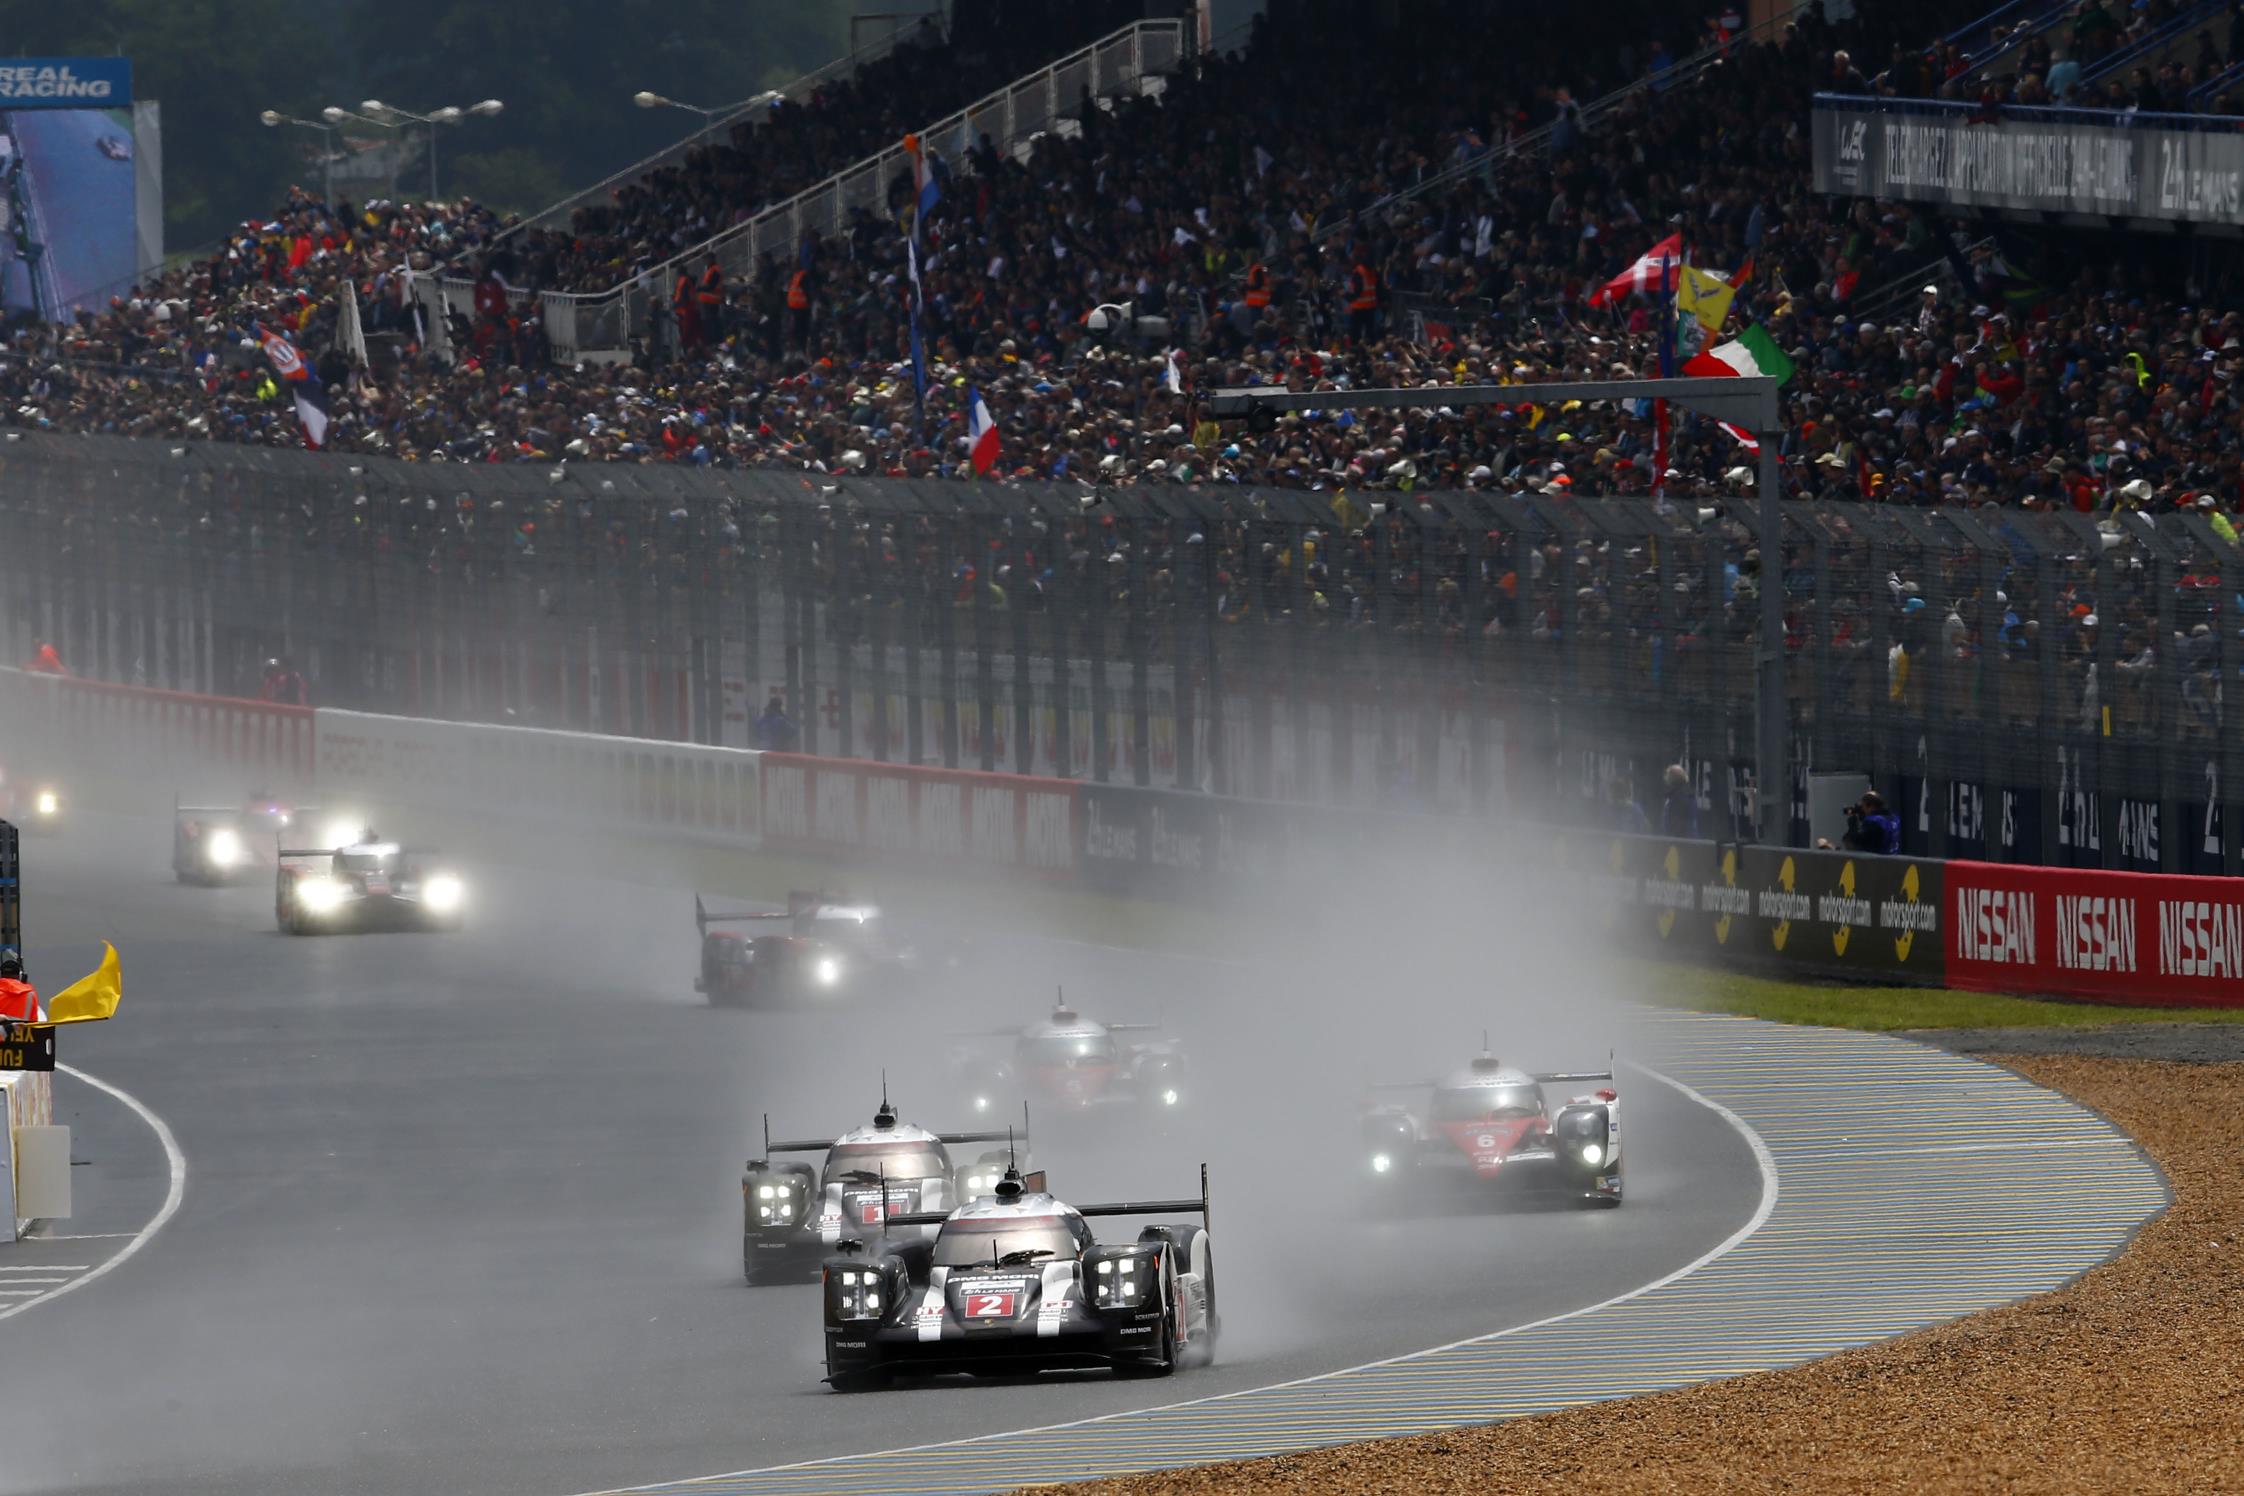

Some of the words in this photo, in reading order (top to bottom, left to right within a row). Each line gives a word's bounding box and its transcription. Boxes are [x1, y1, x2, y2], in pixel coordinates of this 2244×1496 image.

[0, 66, 78, 81] REAL
[0, 80, 112, 97] RACING
[1758, 885, 1811, 921] motorsport.com
[1818, 890, 1872, 928] motorsport.com
[1880, 895, 1936, 934] motorsport.com
[1957, 887, 2036, 965] NISSAN
[2056, 895, 2137, 973] NISSAN
[2159, 900, 2244, 979] NISSAN
[1477, 1135, 1497, 1148] 6
[992, 1273, 1040, 1281] MORI
[976, 1295, 1003, 1316] 2
[1120, 1327, 1137, 1335] DMG
